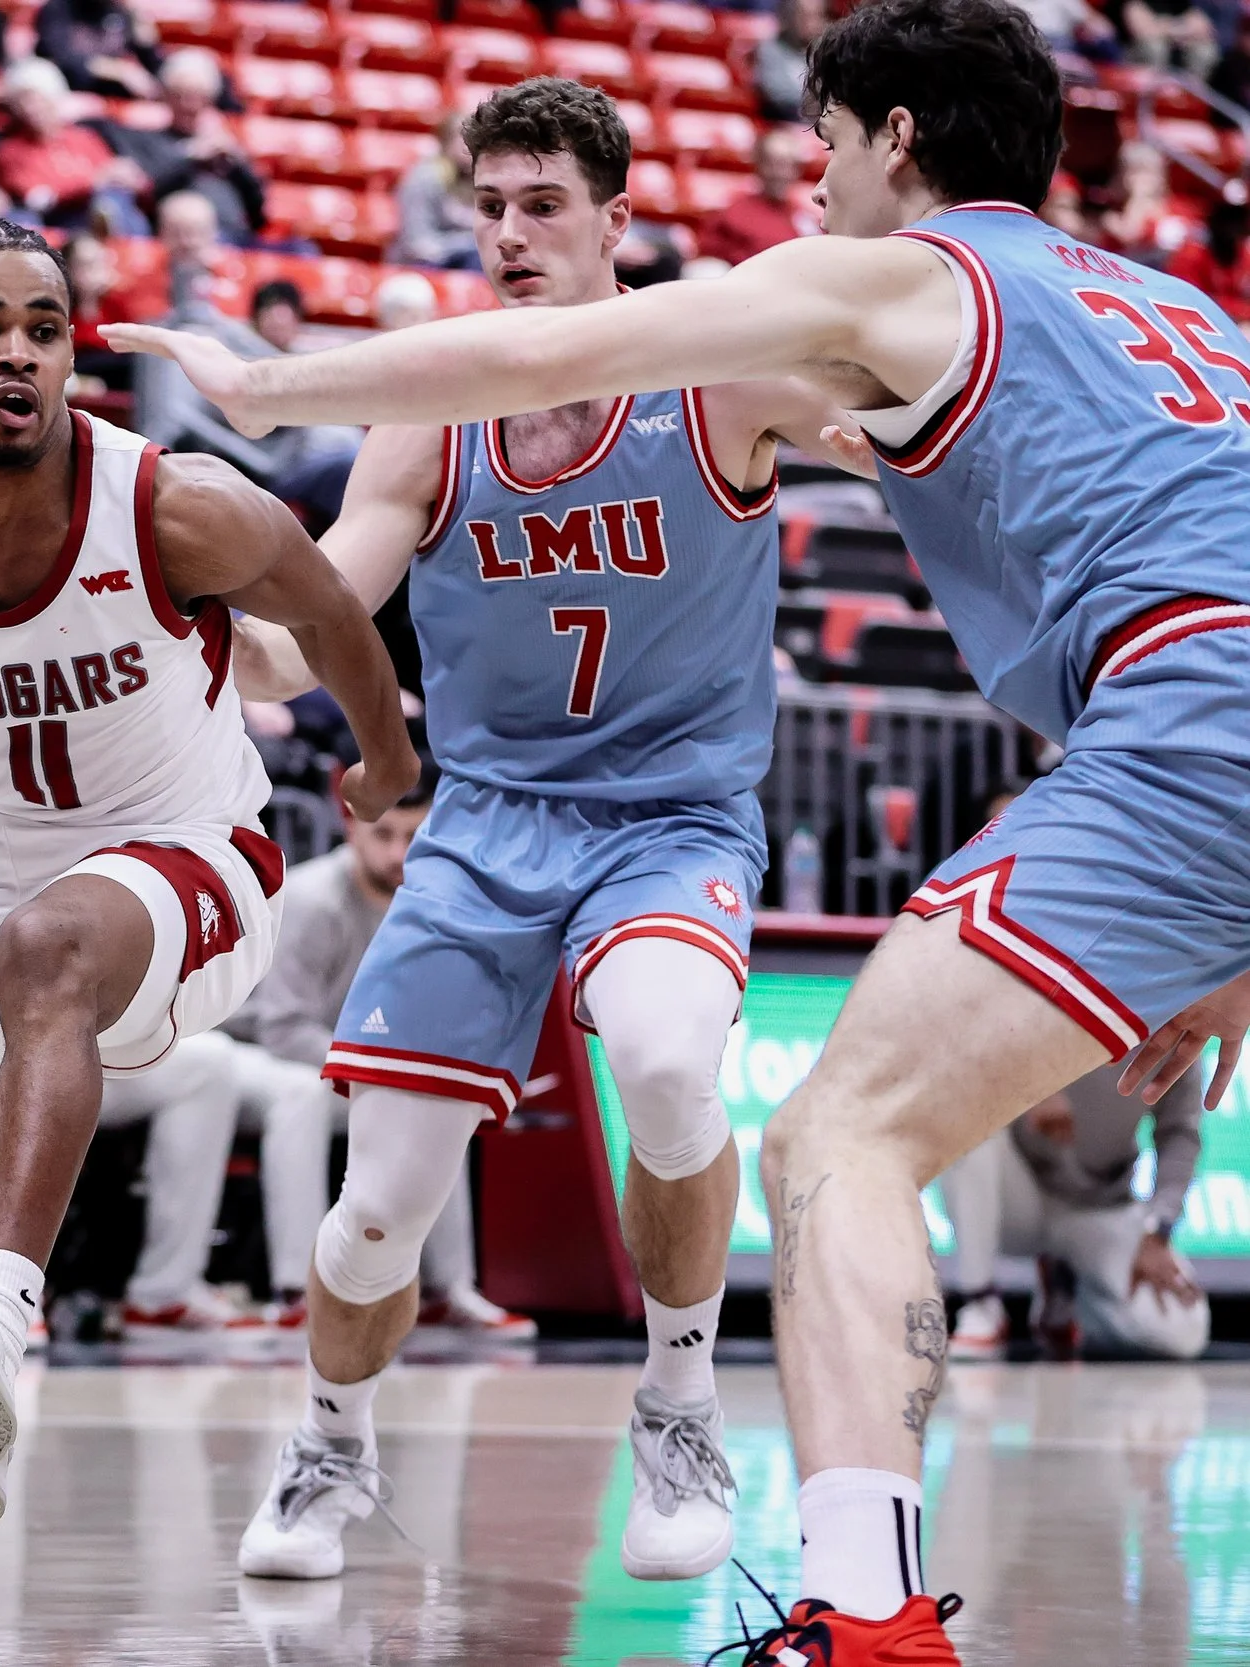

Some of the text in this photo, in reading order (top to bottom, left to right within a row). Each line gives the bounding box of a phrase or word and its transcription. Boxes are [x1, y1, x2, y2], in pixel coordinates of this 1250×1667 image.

[1070, 287, 1250, 428] 35
[629, 412, 679, 435] WCC
[465, 496, 670, 582] LMU
[549, 606, 611, 719] 7
[6, 719, 82, 809] 11
